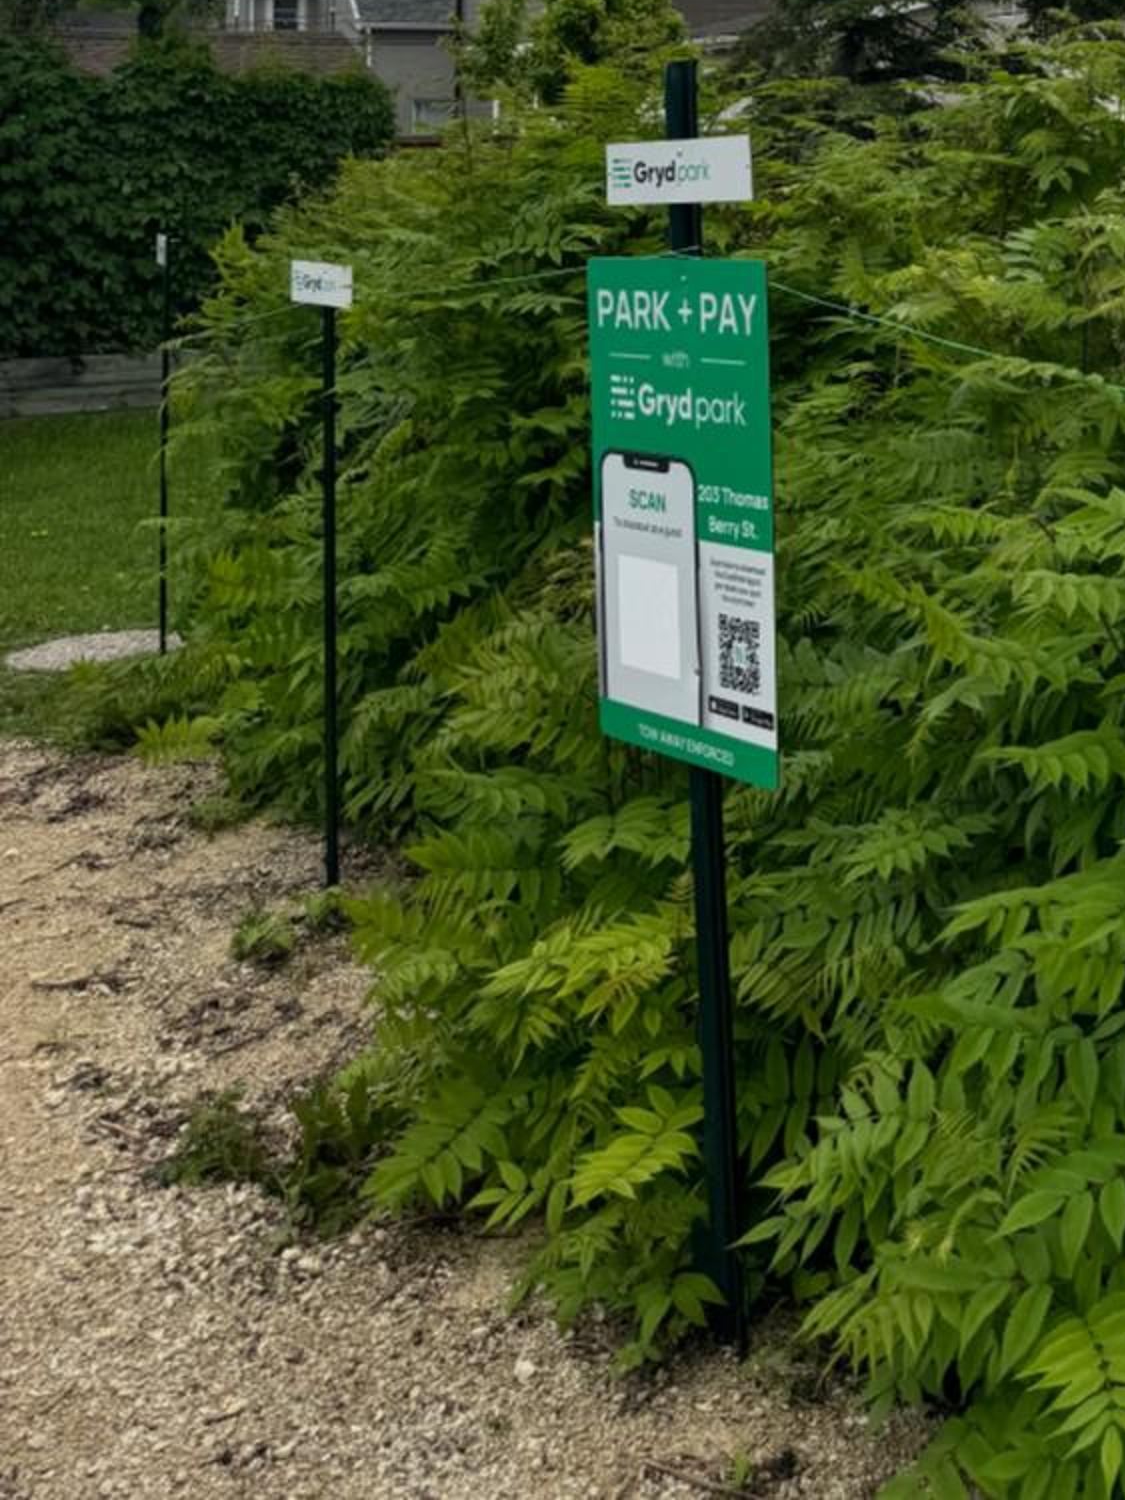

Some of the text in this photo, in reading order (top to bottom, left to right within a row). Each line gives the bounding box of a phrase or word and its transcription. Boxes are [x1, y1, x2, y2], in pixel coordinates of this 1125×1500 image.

[597, 289, 757, 336] PARK + PAY
[662, 352, 690, 368] with
[629, 488, 667, 513] SCAN
[721, 486, 769, 511] Thomas
[708, 515, 739, 541] Berry
